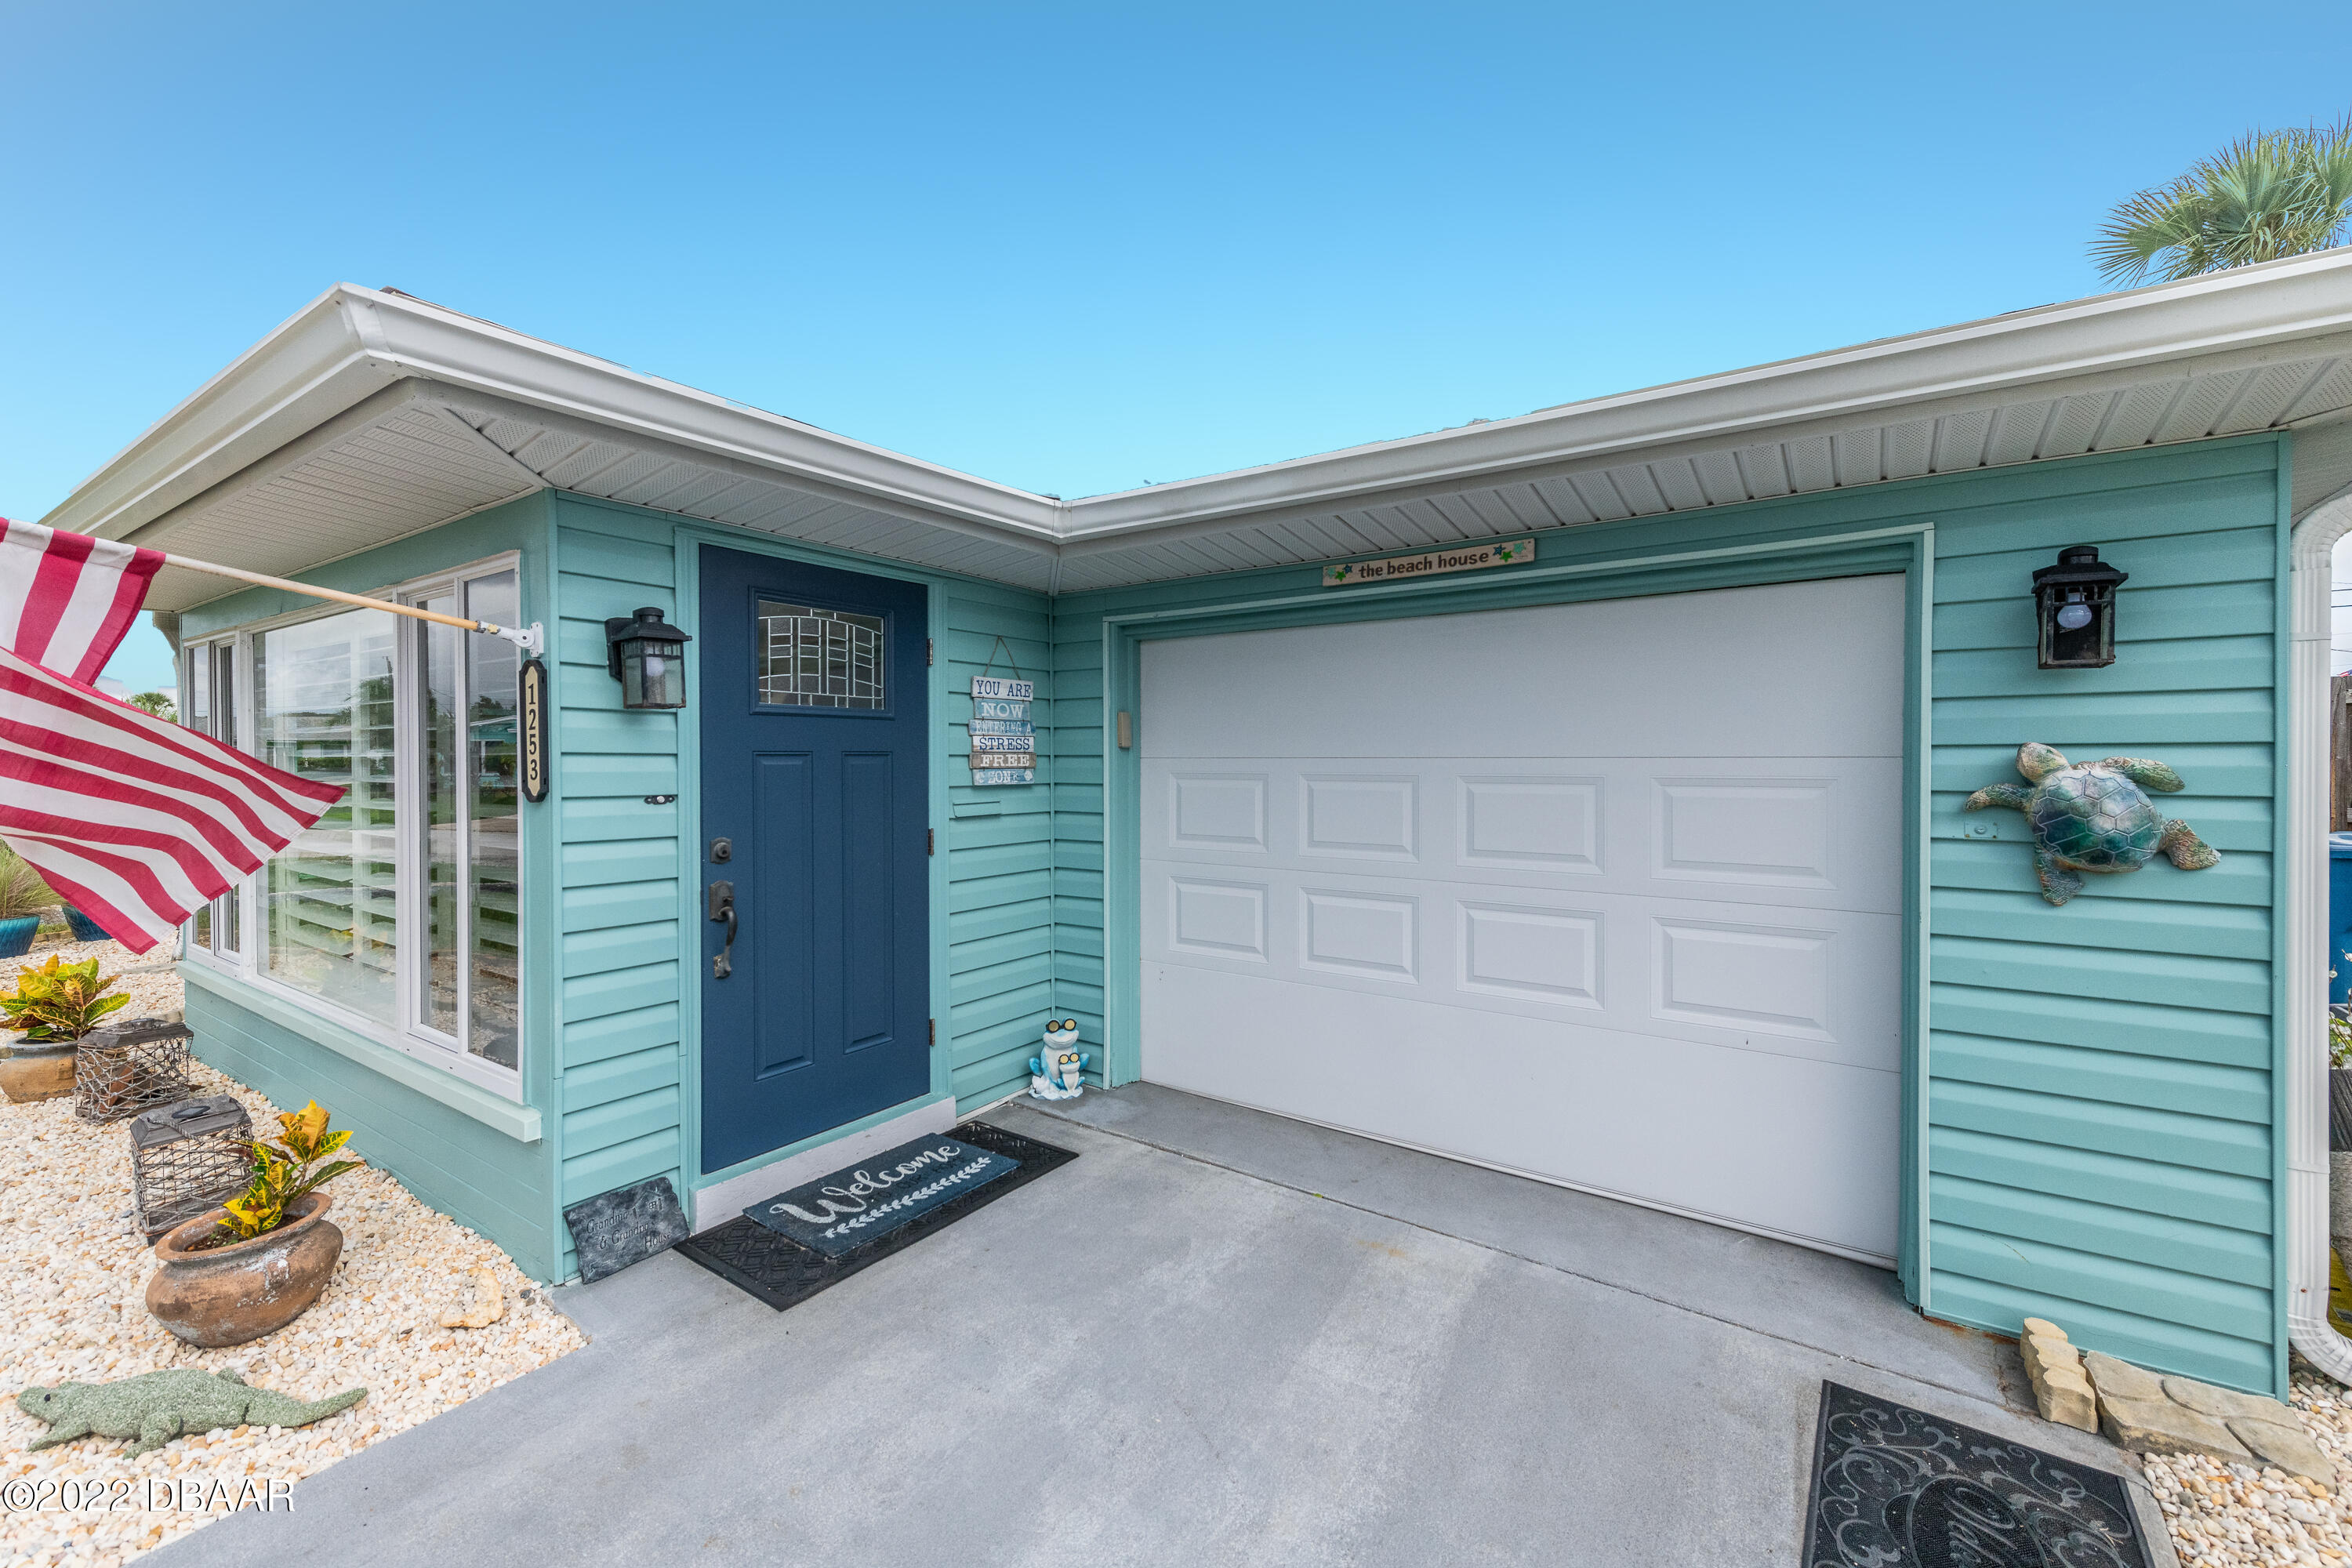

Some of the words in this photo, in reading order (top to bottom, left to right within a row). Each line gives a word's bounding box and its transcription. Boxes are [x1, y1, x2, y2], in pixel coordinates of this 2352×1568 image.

[1358, 564, 1383, 579] the
[1387, 555, 1432, 575] beach
[1438, 551, 1489, 569] house
[975, 679, 1000, 695] YOU
[1007, 683, 1032, 699] ARE
[981, 702, 1025, 717] NOW
[528, 683, 538, 781] 1253
[976, 720, 1022, 735] ENTERING
[1025, 722, 1033, 735] A
[979, 737, 1030, 750] STRESS
[980, 753, 1030, 767] FREE
[988, 770, 1019, 784] ZONE
[769, 1145, 960, 1225] Welcome
